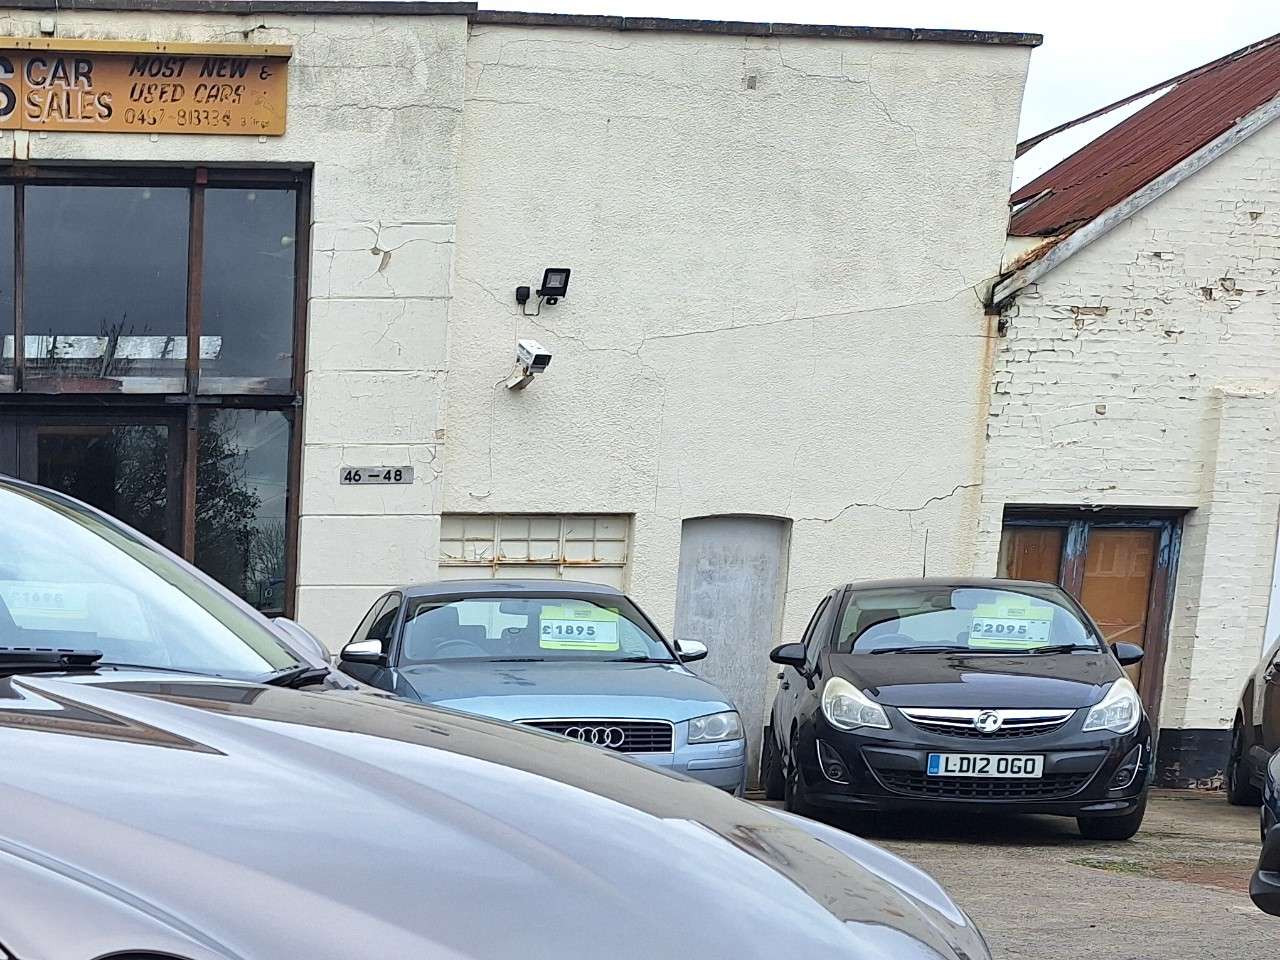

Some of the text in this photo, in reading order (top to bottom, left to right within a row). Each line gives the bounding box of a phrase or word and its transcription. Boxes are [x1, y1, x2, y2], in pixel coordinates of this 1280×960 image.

[26, 57, 94, 88] CAR
[129, 57, 272, 80] MOST NEW &
[26, 90, 113, 120] SALES
[129, 83, 246, 105] USED CARS
[542, 625, 596, 636] £1895
[973, 622, 1027, 634] £2095
[944, 757, 1036, 775] LD12 OGO
